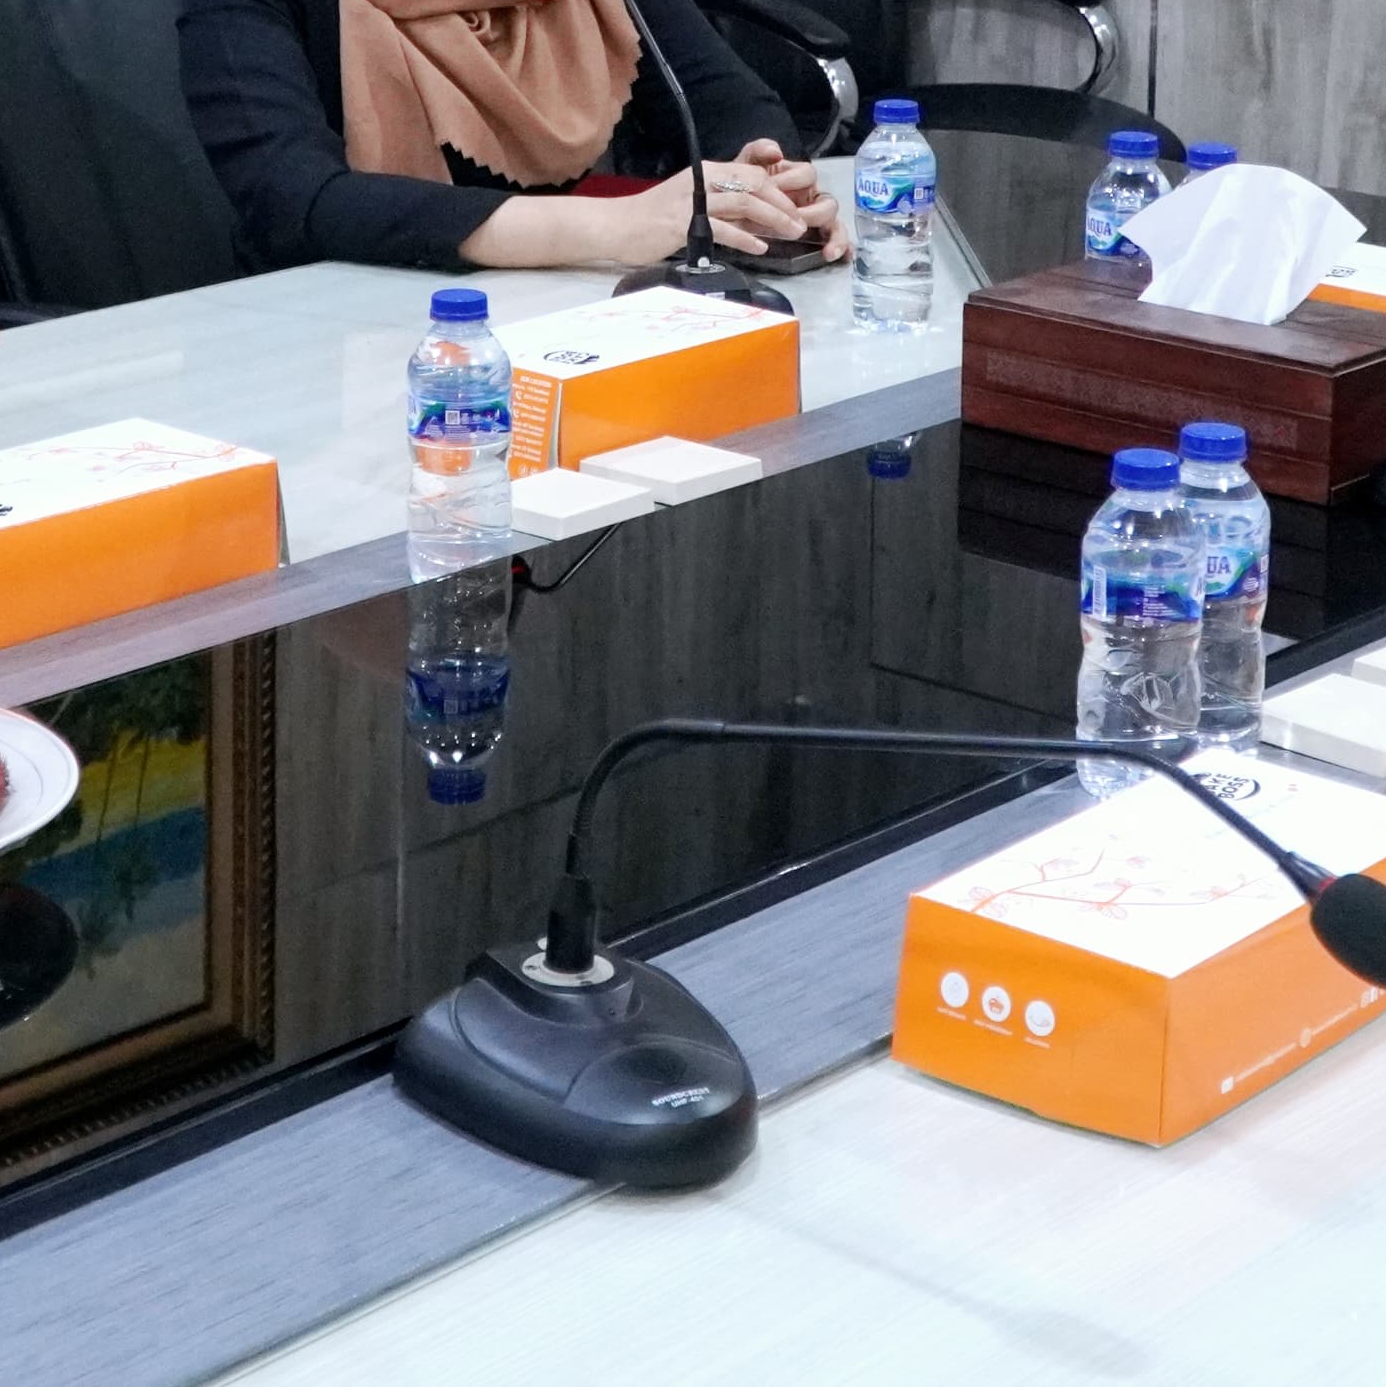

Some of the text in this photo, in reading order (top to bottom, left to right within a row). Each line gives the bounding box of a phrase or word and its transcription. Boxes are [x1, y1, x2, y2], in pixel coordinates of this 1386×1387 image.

[858, 178, 889, 198] AQUA
[1205, 773, 1233, 792] AKE
[1217, 777, 1251, 799] BOSS
